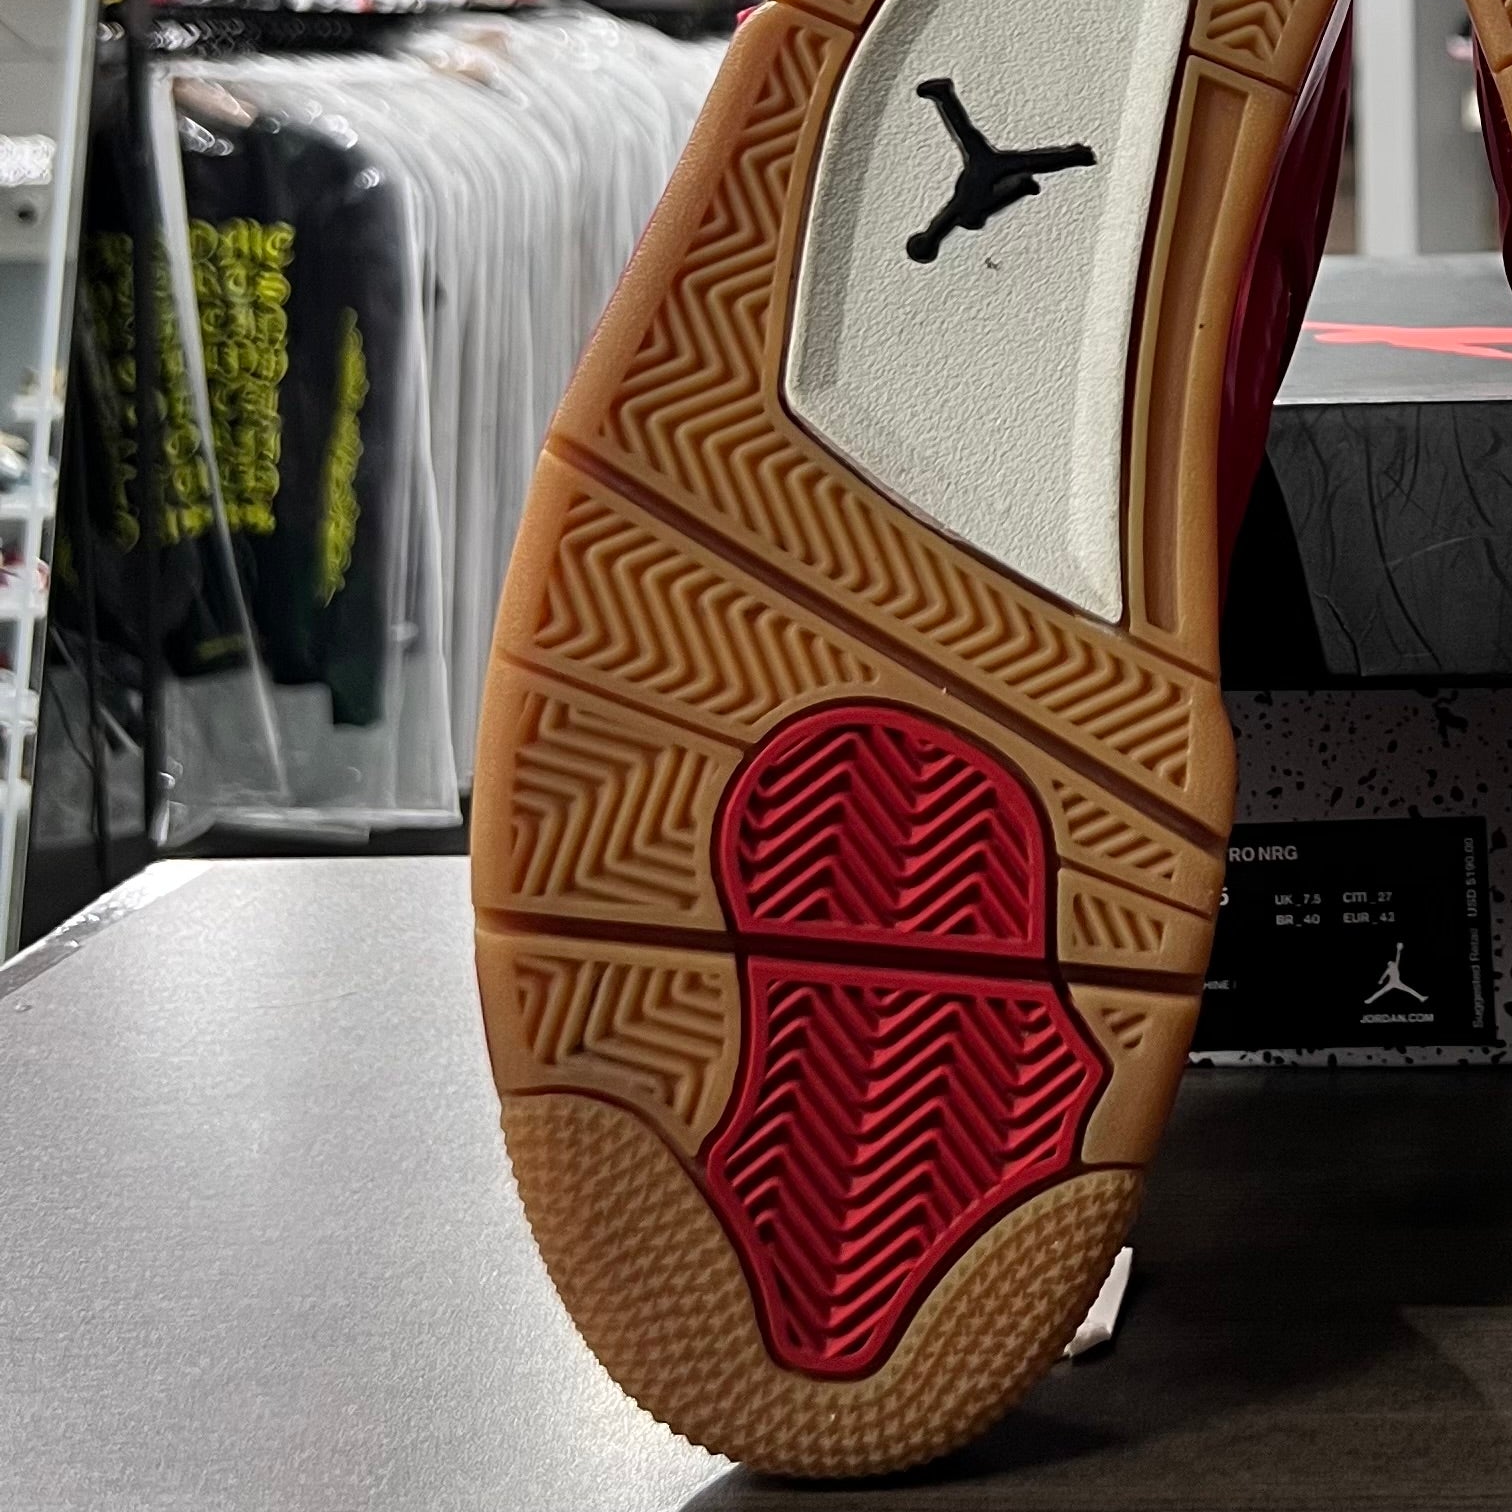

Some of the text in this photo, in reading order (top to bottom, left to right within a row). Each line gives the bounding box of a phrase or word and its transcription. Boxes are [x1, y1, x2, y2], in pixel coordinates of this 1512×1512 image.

[1229, 845, 1299, 862] RO NRG
[1466, 889, 1478, 918] USD
[1471, 964, 1486, 1029] Suggested
[1359, 1013, 1435, 1024] JORDAN.COM
